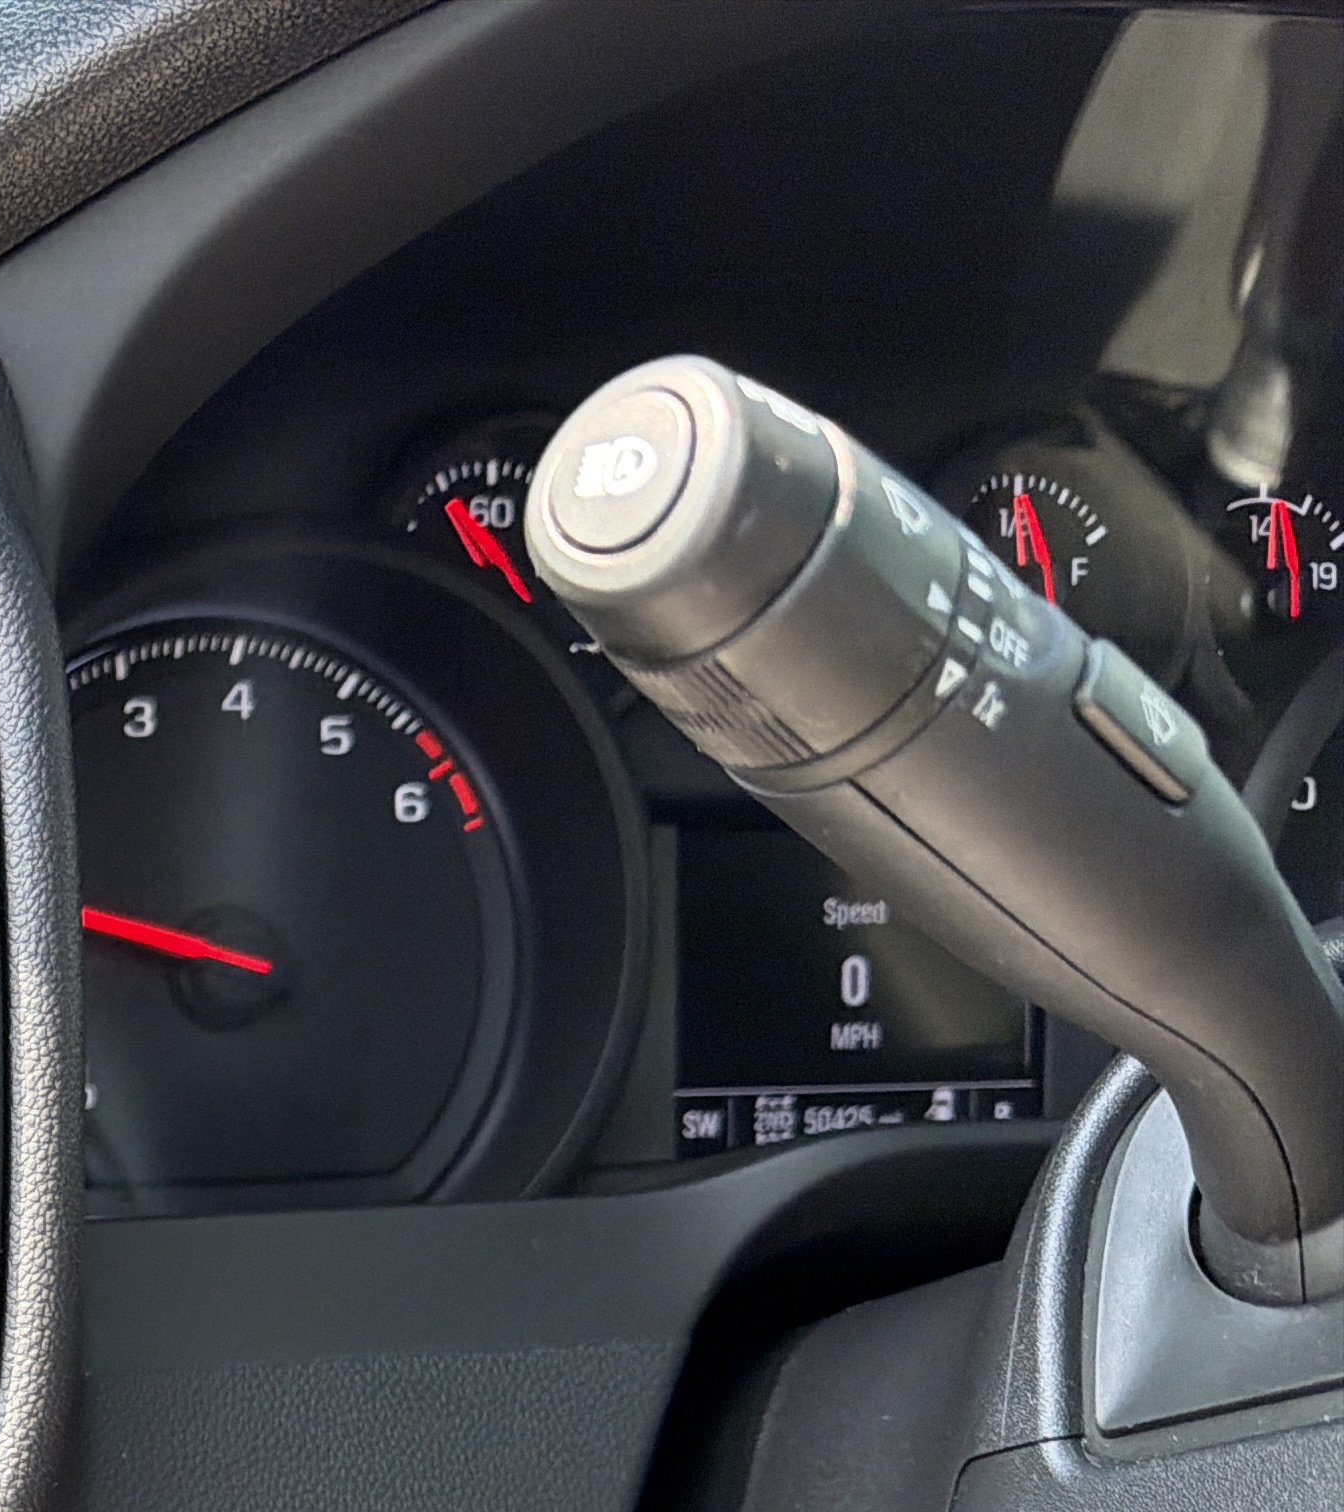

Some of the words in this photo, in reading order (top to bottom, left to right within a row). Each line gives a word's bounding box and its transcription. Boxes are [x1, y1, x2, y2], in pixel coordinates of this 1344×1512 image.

[469, 495, 515, 529] 60
[1071, 556, 1089, 586] F
[1309, 561, 1337, 591] 19
[989, 617, 1030, 668] OFF
[123, 696, 158, 738] 3
[221, 679, 256, 720] 4
[319, 714, 355, 756] 5
[394, 782, 430, 823] 6
[823, 898, 889, 929] Speed
[840, 954, 870, 1008] 0
[830, 1022, 883, 1052] MPH
[682, 1109, 720, 1139] SW
